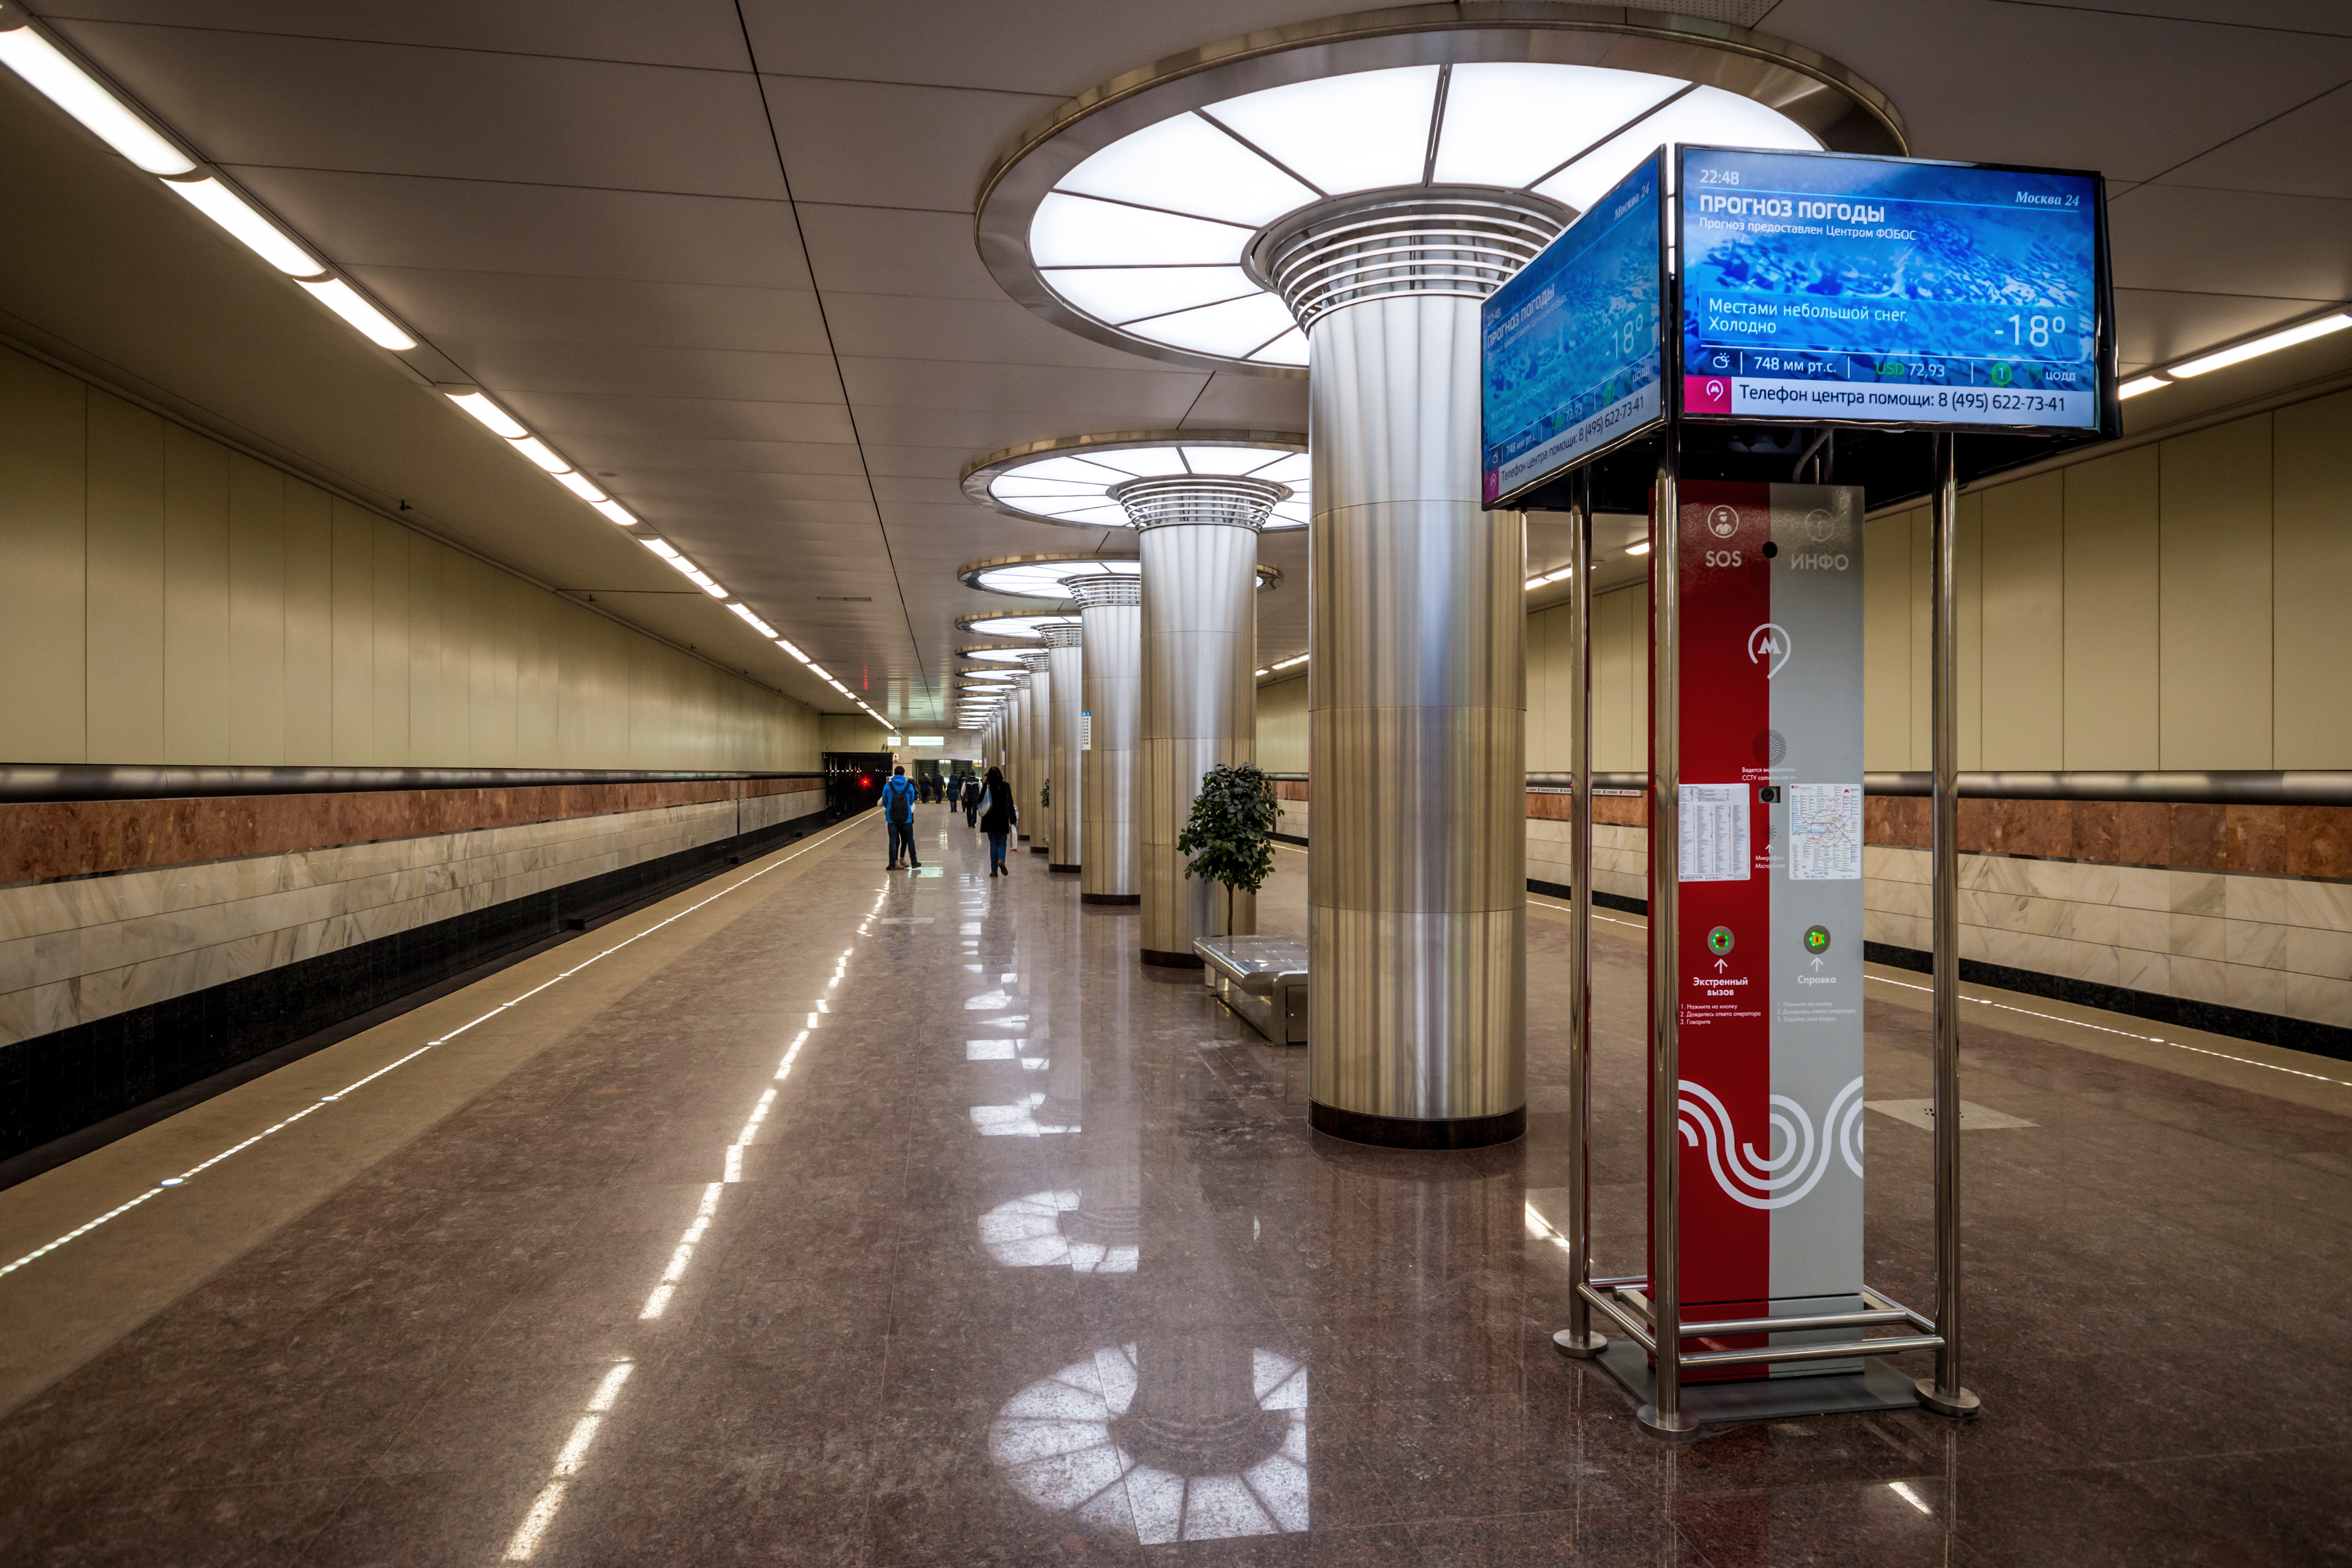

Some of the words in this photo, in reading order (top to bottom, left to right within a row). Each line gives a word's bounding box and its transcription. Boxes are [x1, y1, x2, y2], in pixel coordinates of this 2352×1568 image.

[1700, 170, 1740, 185] 22:48
[1614, 194, 1639, 221] Москва
[1641, 181, 1649, 199] 24
[2015, 191, 2061, 205] Москва
[2064, 194, 2080, 206] 24
[1700, 195, 1792, 217] ПРОГНОЗ
[1798, 201, 1885, 224] ПОГОДЫ
[1699, 218, 1744, 230] Прогноз
[1748, 222, 1823, 235] предоставлен
[1826, 225, 1873, 239] Центром
[1876, 229, 1917, 240] ФОБОС
[1488, 312, 1519, 348] ПРОГНОЗ
[1521, 283, 1555, 322] ПОГОДЫ
[1488, 307, 1501, 326] 22:48
[1709, 298, 1777, 316] Местами
[1783, 303, 1868, 320] небольшой
[1875, 309, 1908, 322] снег.
[1709, 316, 1776, 335] Холодно
[1754, 357, 1780, 370] 748
[1784, 361, 1804, 371] мм
[1808, 363, 1837, 374] рт.с.
[1875, 362, 1905, 376] USD
[1909, 363, 1945, 379] 72,93
[1517, 376, 1549, 405] небольшой
[1740, 385, 1808, 404] Телефон
[1813, 390, 1864, 406] центра
[1869, 392, 1934, 408] помощи:
[1939, 392, 1948, 407] 8
[1952, 392, 1988, 413] (495)
[1992, 395, 2065, 412] 622-73-41
[1491, 415, 1515, 436] Холодно
[1501, 464, 1526, 482] Телефон
[1527, 450, 1548, 468] центра
[1549, 434, 1577, 458] помощи:
[1579, 427, 1584, 441] 8
[1585, 416, 1603, 441] (495)
[1605, 395, 1643, 427] 622-73-41
[1507, 444, 1516, 456] 748
[1705, 551, 1741, 567] SOS
[1791, 553, 1849, 570] ИНФО
[1693, 977, 1748, 988] Экстренный
[1798, 975, 1836, 986] Справка
